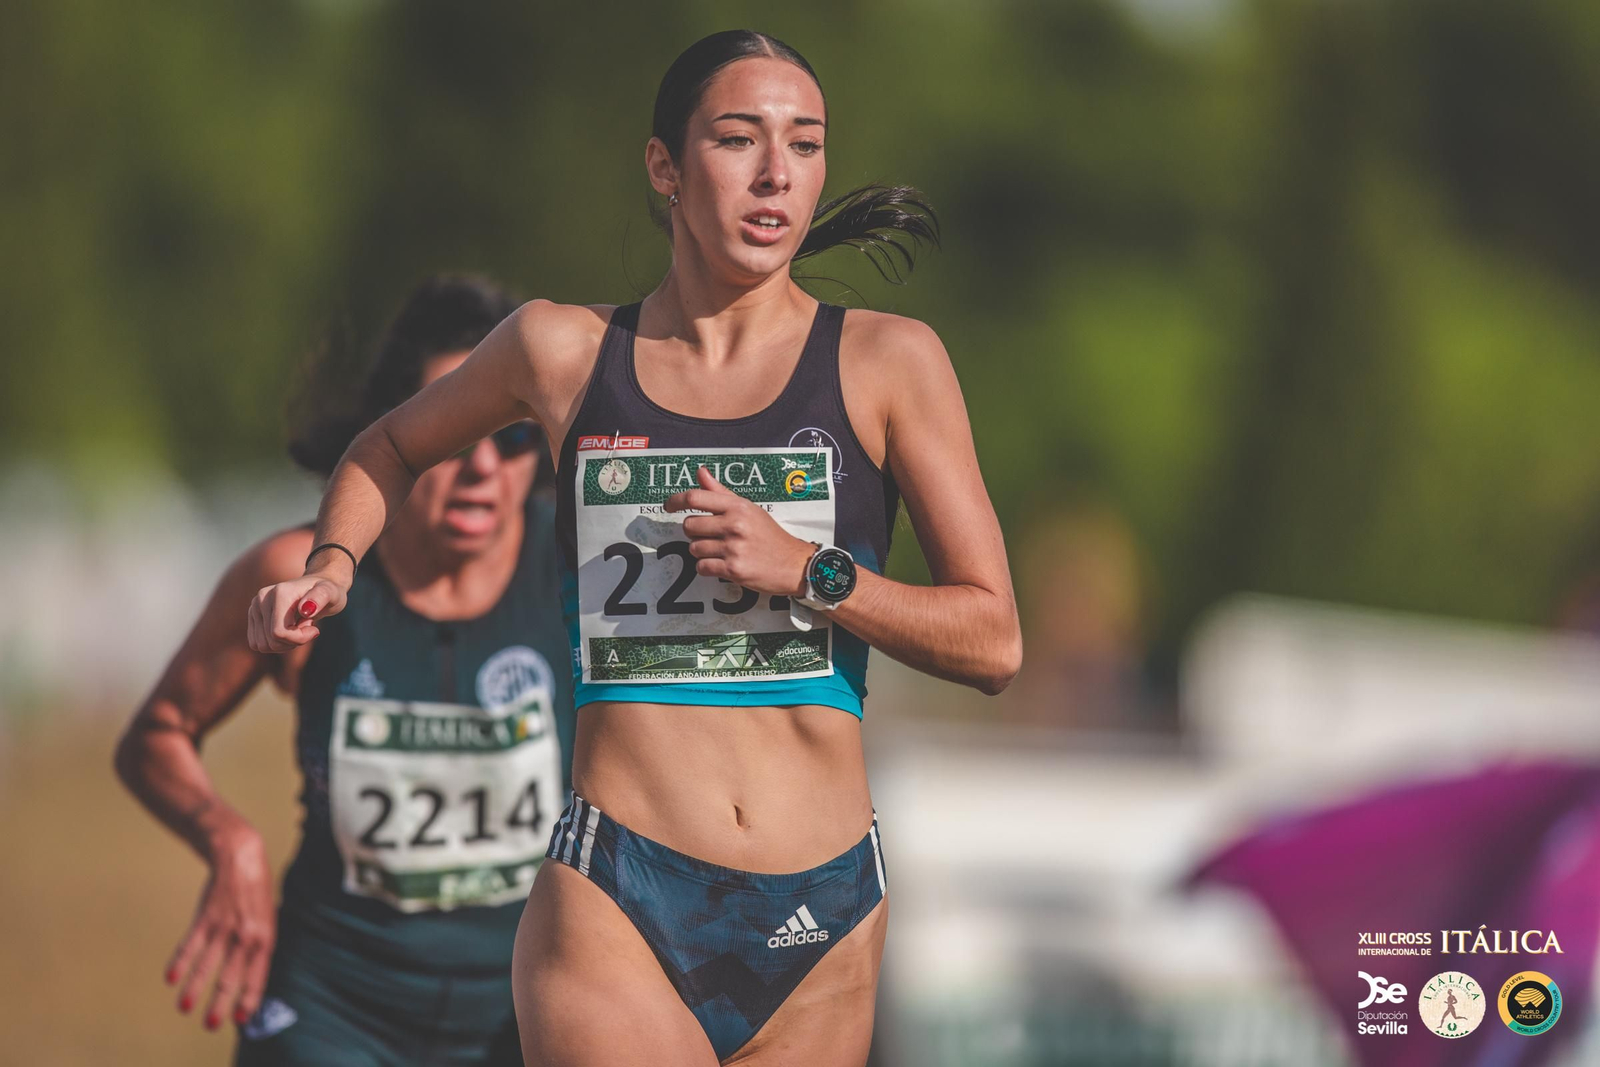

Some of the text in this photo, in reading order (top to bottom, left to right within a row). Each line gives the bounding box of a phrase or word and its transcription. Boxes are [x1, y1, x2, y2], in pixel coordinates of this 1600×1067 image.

[580, 438, 646, 449] EMUGE
[647, 457, 767, 487] ITÁICA
[628, 671, 675, 680] FEDERACIÓN
[679, 671, 719, 679] ANDALUZA
[734, 669, 777, 677] ATLETISMO
[357, 778, 544, 850] 2214
[767, 929, 829, 949] adidas
